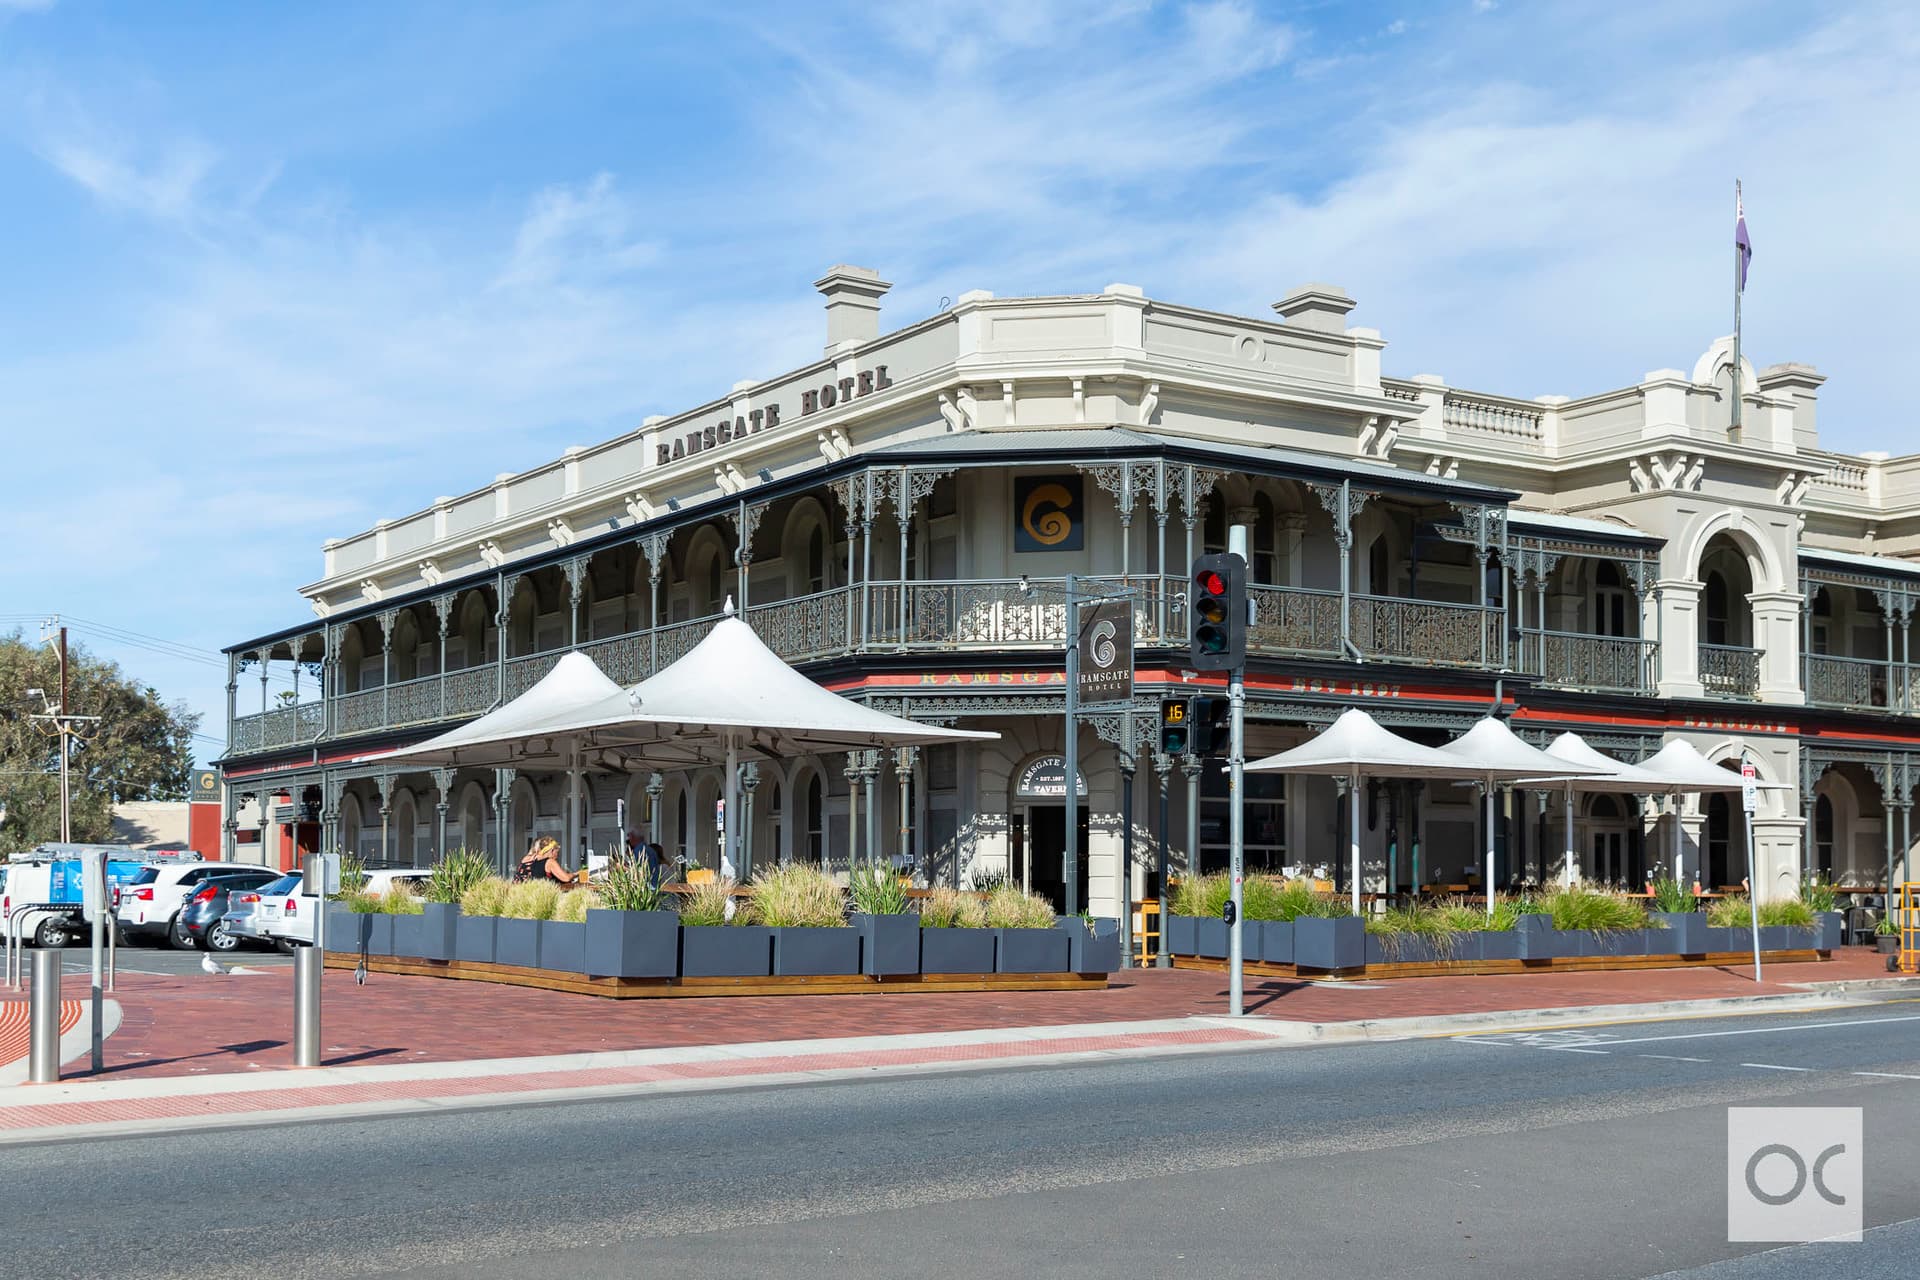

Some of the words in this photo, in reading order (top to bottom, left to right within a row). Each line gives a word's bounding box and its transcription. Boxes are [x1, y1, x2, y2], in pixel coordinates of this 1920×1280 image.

[656, 403, 781, 466] RAMSGATE
[801, 364, 893, 416] HOTEL
[921, 672, 1066, 684] RAMSGA
[1081, 669, 1129, 683] RAMSGATE
[1088, 682, 1122, 692] HOTEL
[1169, 704, 1183, 721] 16
[1022, 759, 1060, 790] RAMSGATE
